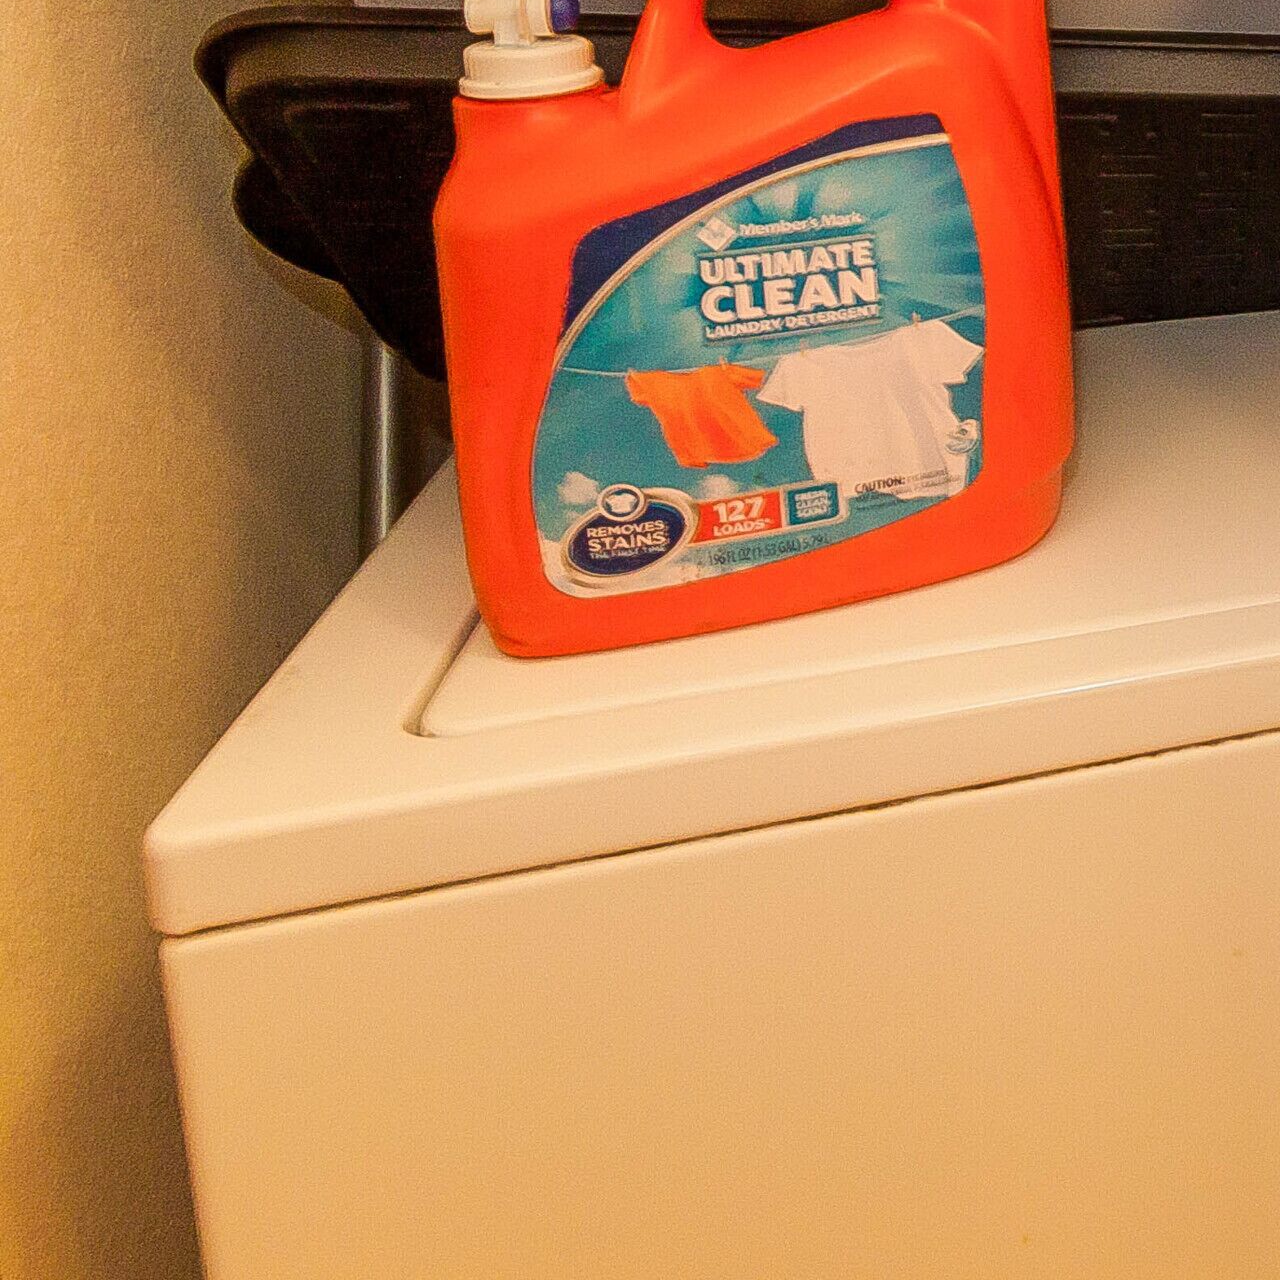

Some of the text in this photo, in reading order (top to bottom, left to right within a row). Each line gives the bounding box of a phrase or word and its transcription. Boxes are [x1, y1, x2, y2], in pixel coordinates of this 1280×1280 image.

[739, 211, 864, 237] Member's Mark
[700, 240, 876, 287] ULTIMATE
[701, 267, 880, 324] CLEAN
[704, 304, 881, 339] LAUNDRY DETERGENT
[854, 476, 906, 494] CAUTION:
[713, 496, 764, 523] 127
[586, 520, 666, 538] REMOVES
[588, 531, 667, 552] STAINS
